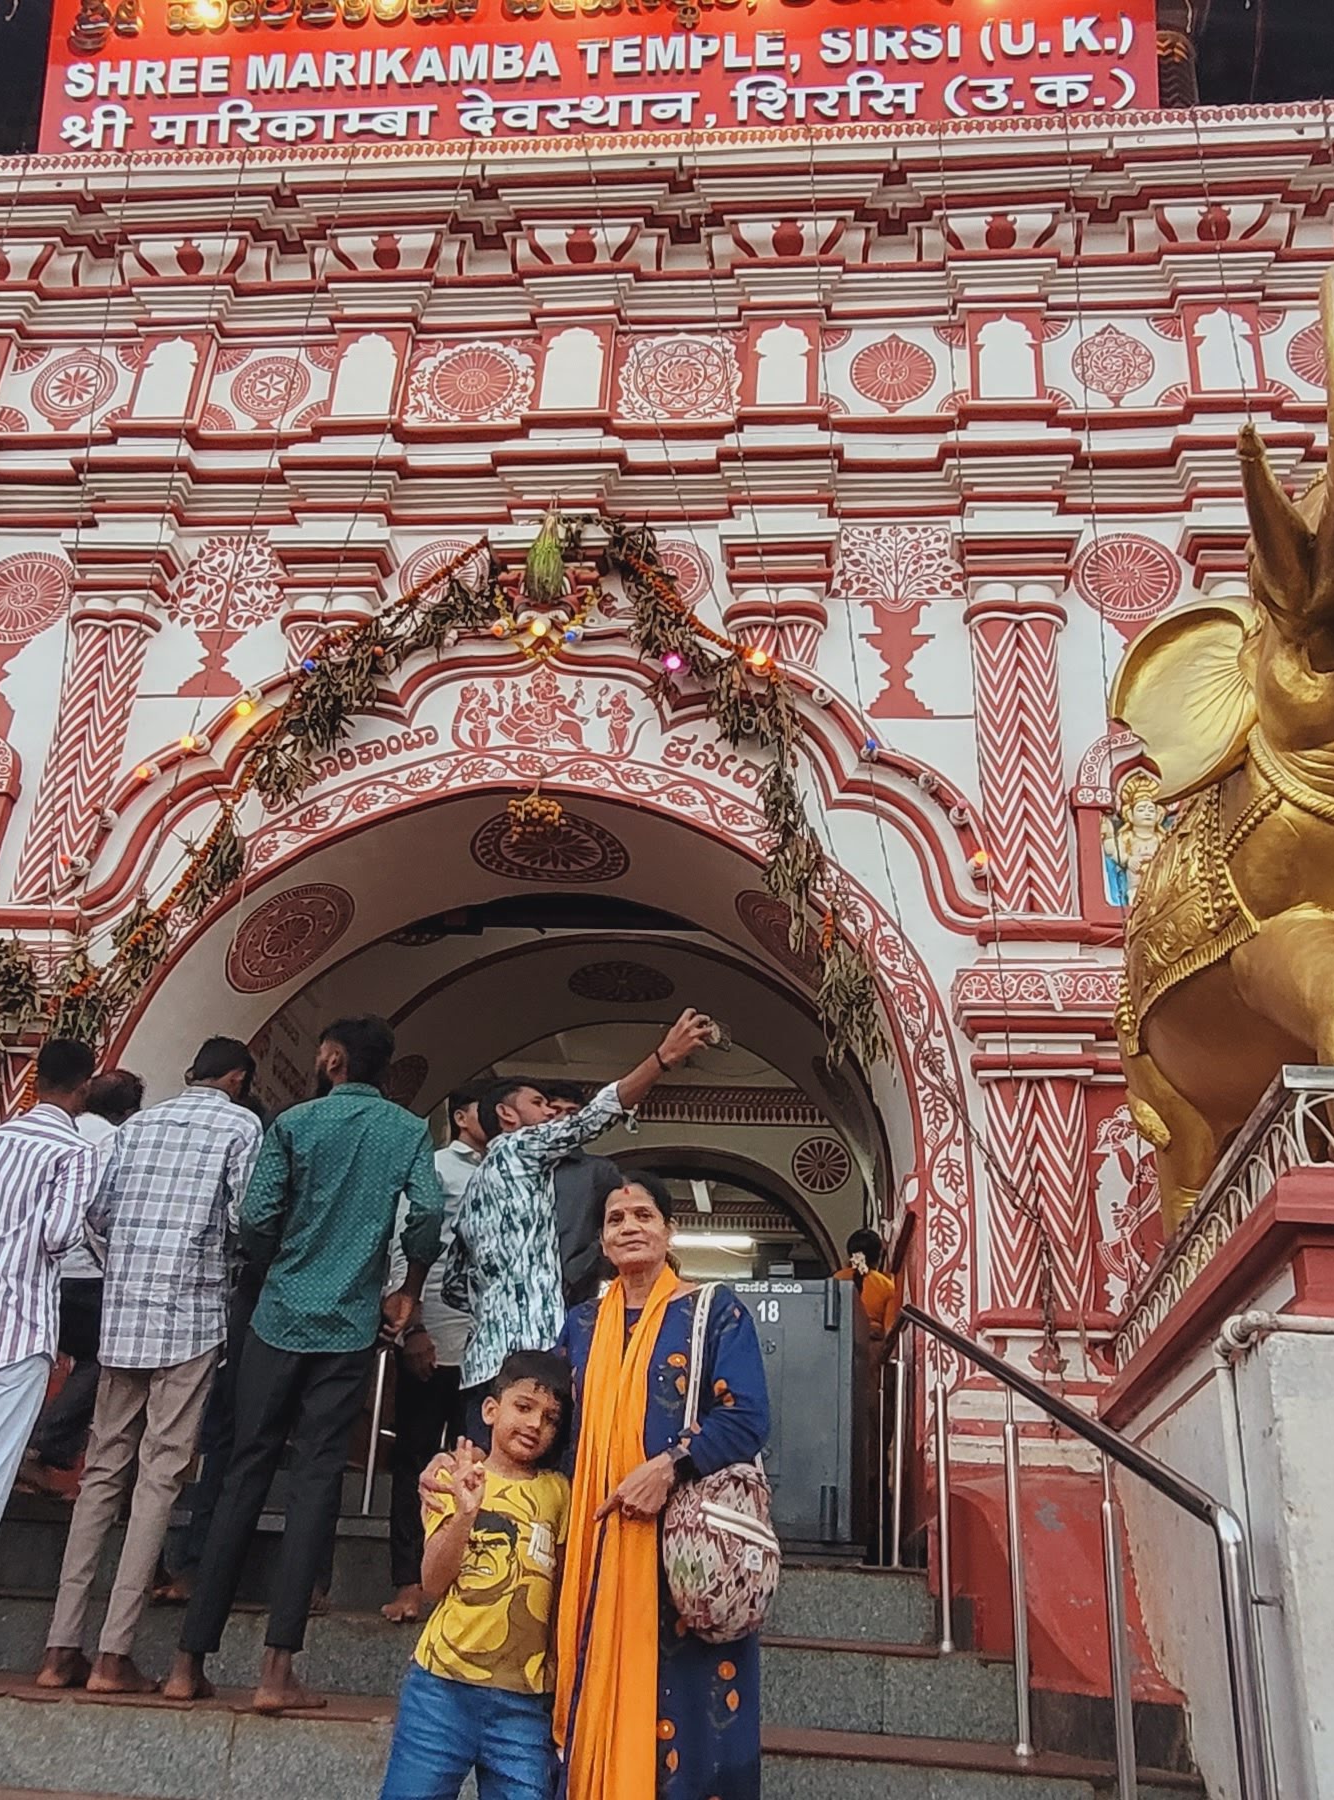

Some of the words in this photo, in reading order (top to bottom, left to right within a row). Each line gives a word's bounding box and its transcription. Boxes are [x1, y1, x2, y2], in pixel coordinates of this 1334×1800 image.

[64, 56, 231, 98] SHREE
[246, 42, 561, 92] MARIKAMBA
[578, 29, 801, 75] TEMPLE,
[820, 23, 961, 64] SIRSI
[59, 105, 134, 149] श्री
[149, 100, 439, 146] मारिकाम्बा
[732, 69, 925, 122] शिरसि
[757, 1300, 779, 1322] 18
